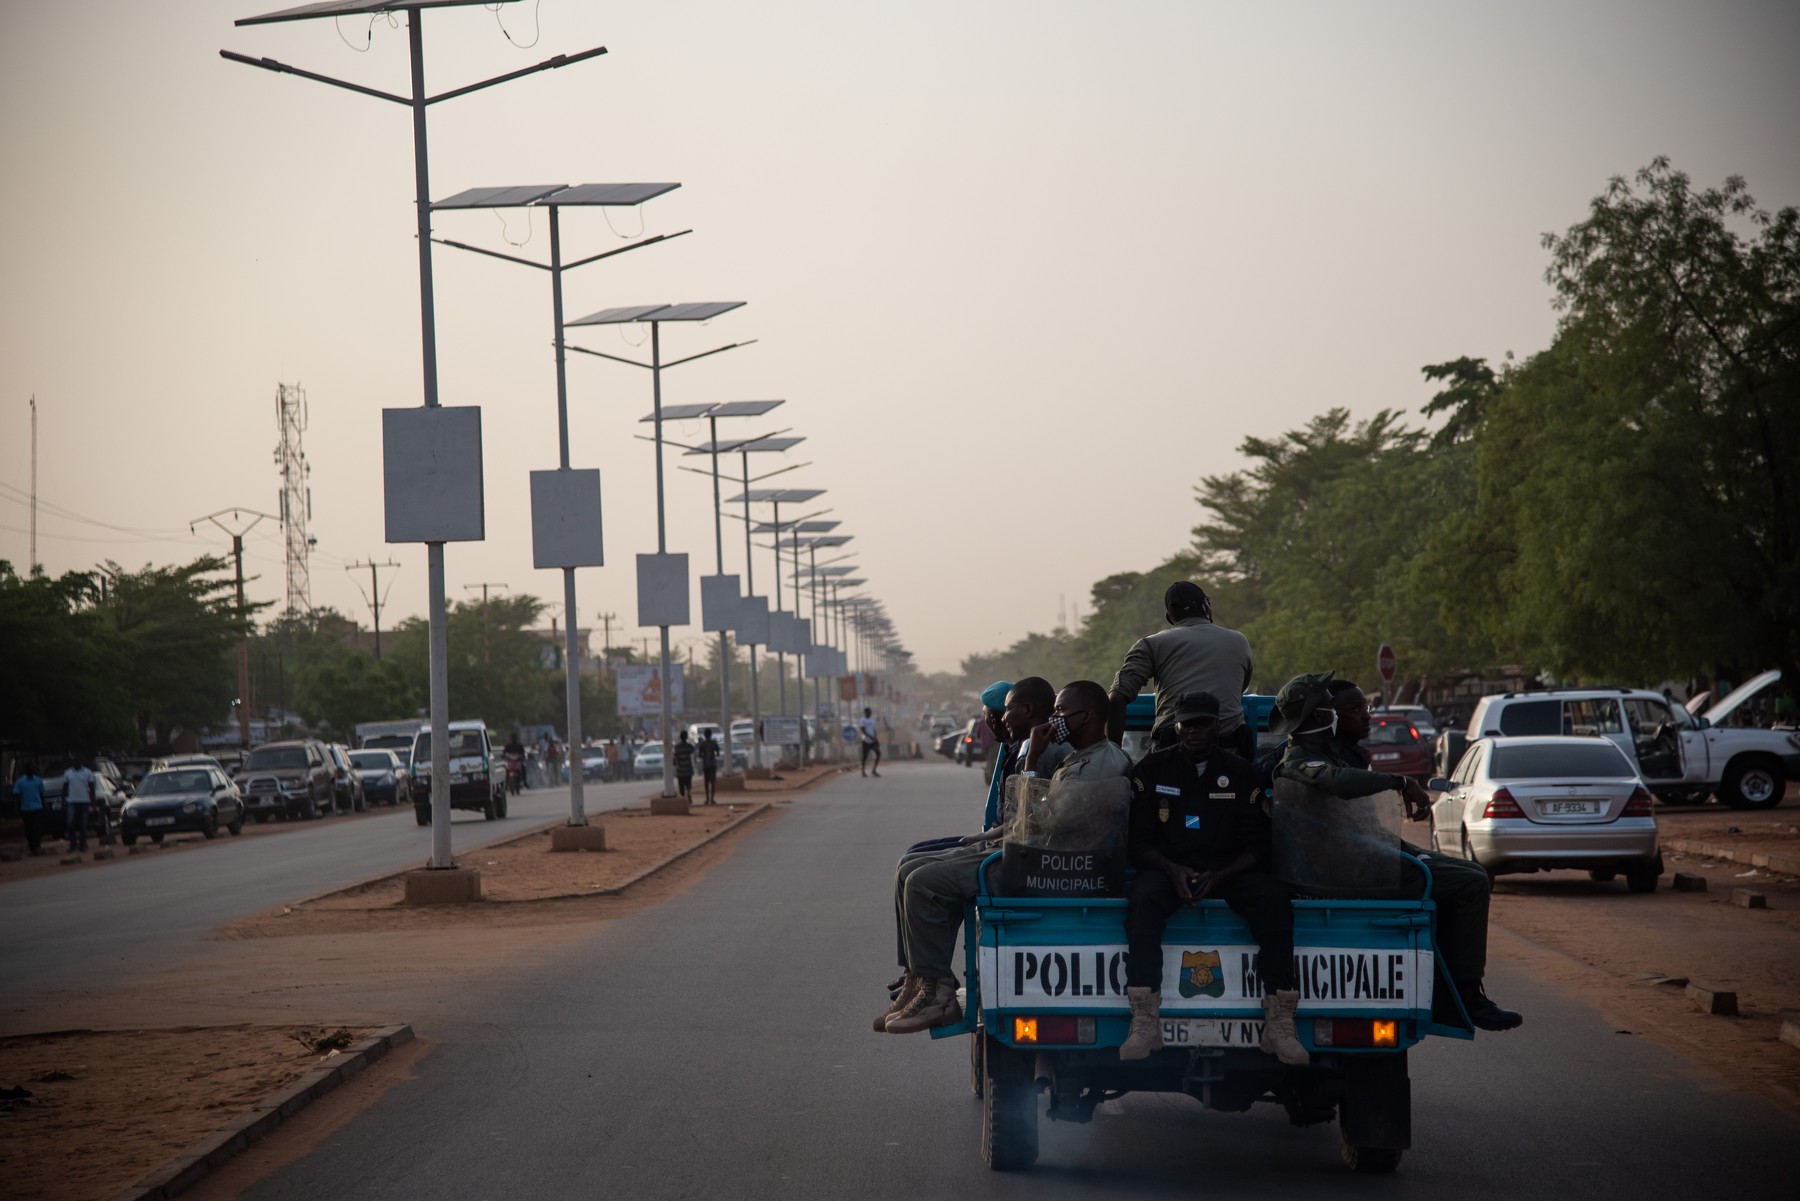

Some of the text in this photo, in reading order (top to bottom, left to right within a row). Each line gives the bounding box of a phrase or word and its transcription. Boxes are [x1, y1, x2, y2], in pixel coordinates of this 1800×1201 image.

[1041, 854, 1094, 871] POLICE
[1026, 875, 1105, 891] MUNICIPALE
[1015, 951, 1404, 1000] POLIC MICIPALE
[1221, 1022, 1232, 1043] V
